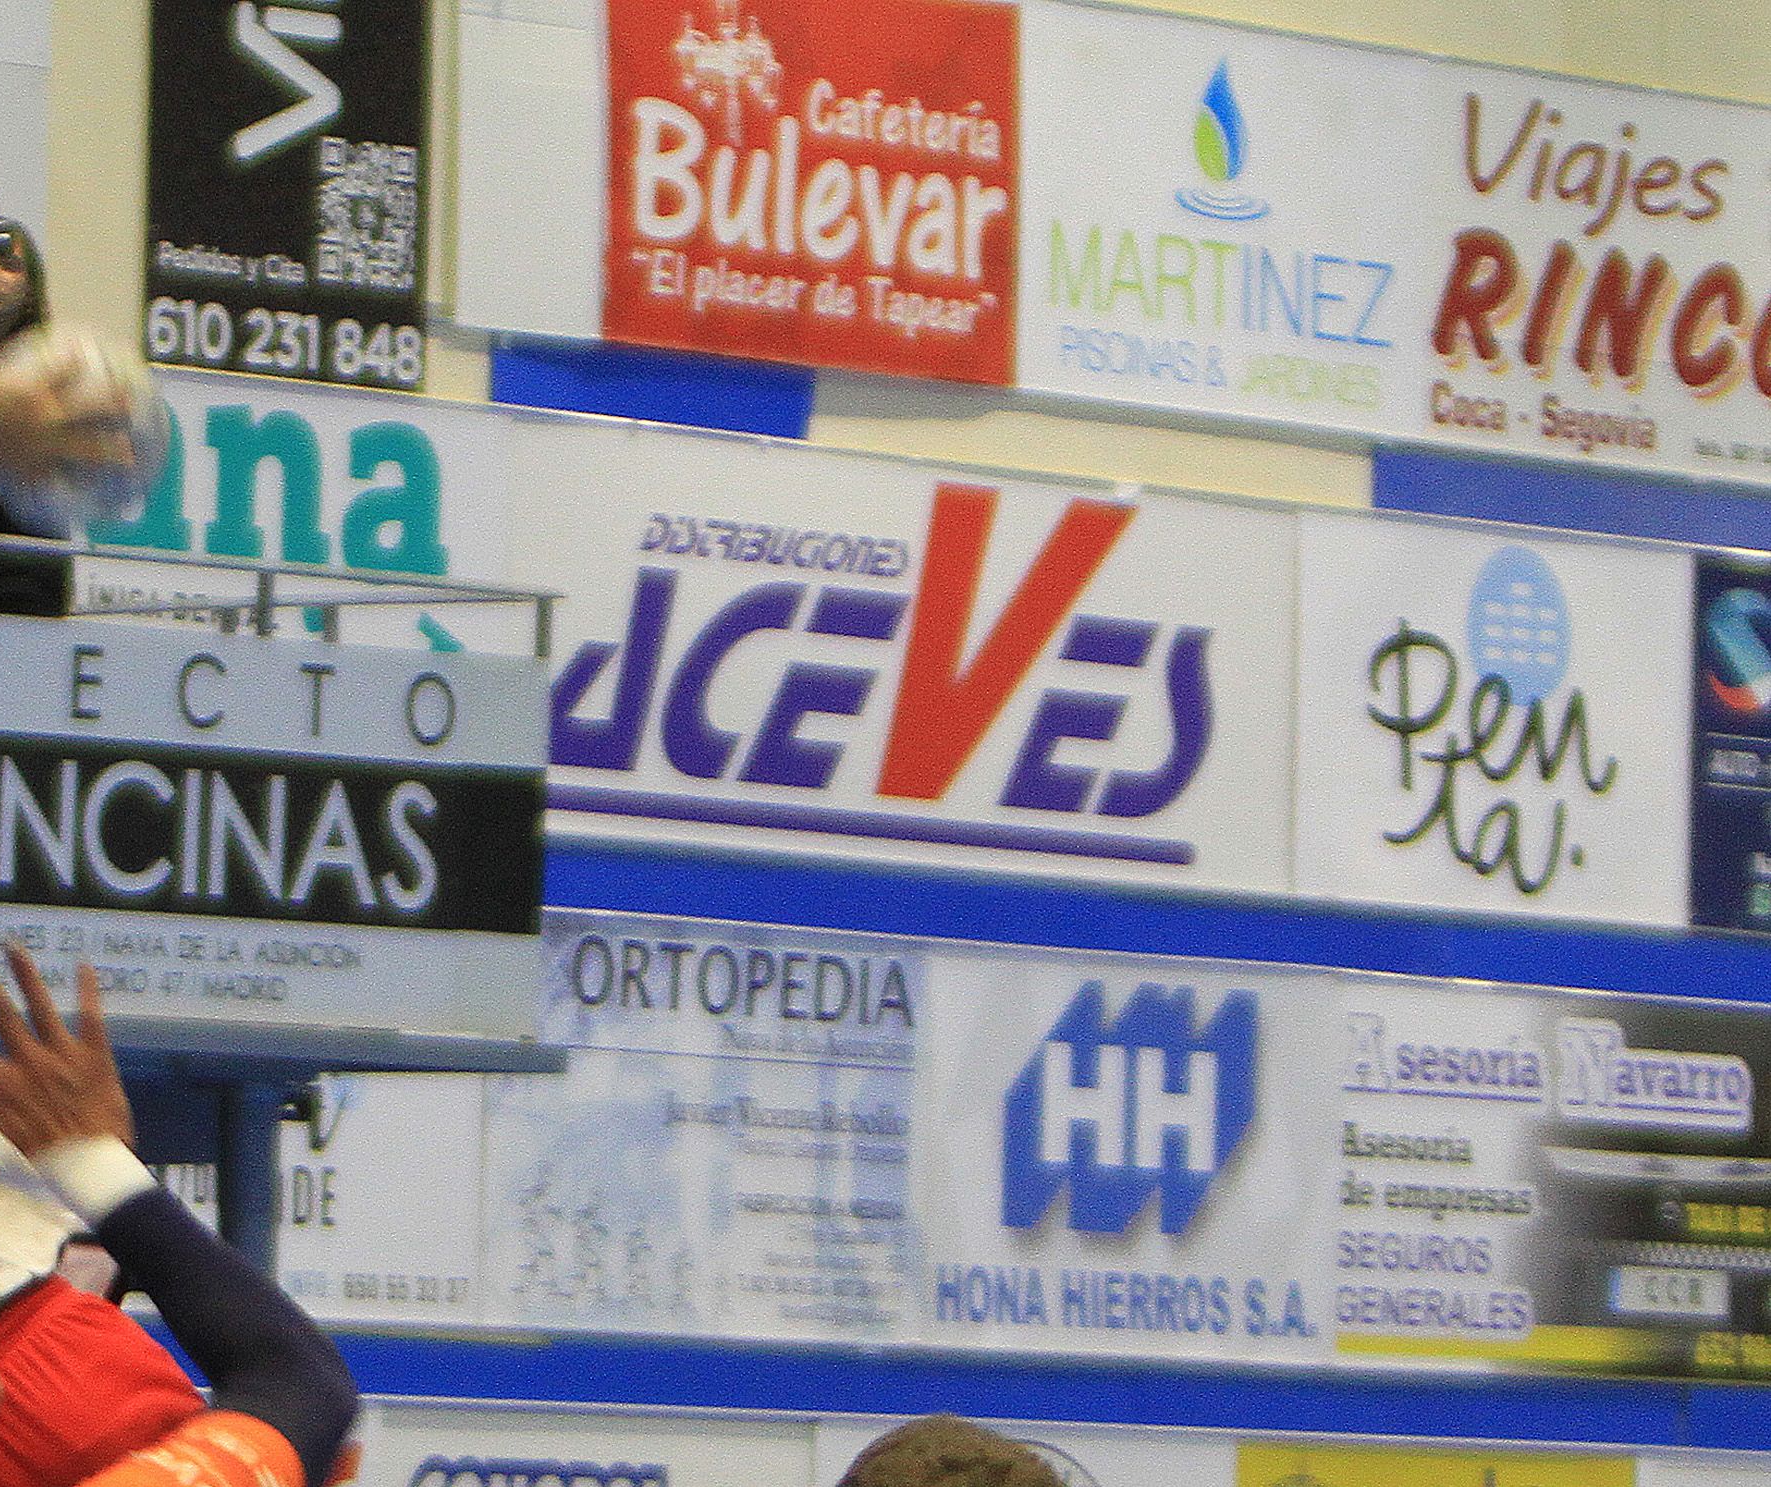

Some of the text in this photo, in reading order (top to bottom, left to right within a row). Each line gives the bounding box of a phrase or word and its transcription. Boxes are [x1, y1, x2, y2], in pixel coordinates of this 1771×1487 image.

[632, 97, 1007, 280] Bulevar
[1464, 92, 1729, 238] Viajes
[694, 259, 803, 313] placer
[814, 273, 857, 317] de
[1049, 220, 1396, 348] MARTINEZ
[1431, 227, 1771, 403] RINC
[148, 296, 421, 387] 610 231 848
[1540, 391, 1656, 455] Segovia
[571, 934, 915, 1029] ORTOPEDIA
[1041, 1039, 1220, 1173] HH
[934, 1262, 1049, 1326] HONA
[1061, 1267, 1231, 1336] HIERROS
[1337, 1231, 1492, 1275] SEGUROS
[1334, 1285, 1530, 1331] GENERALES
